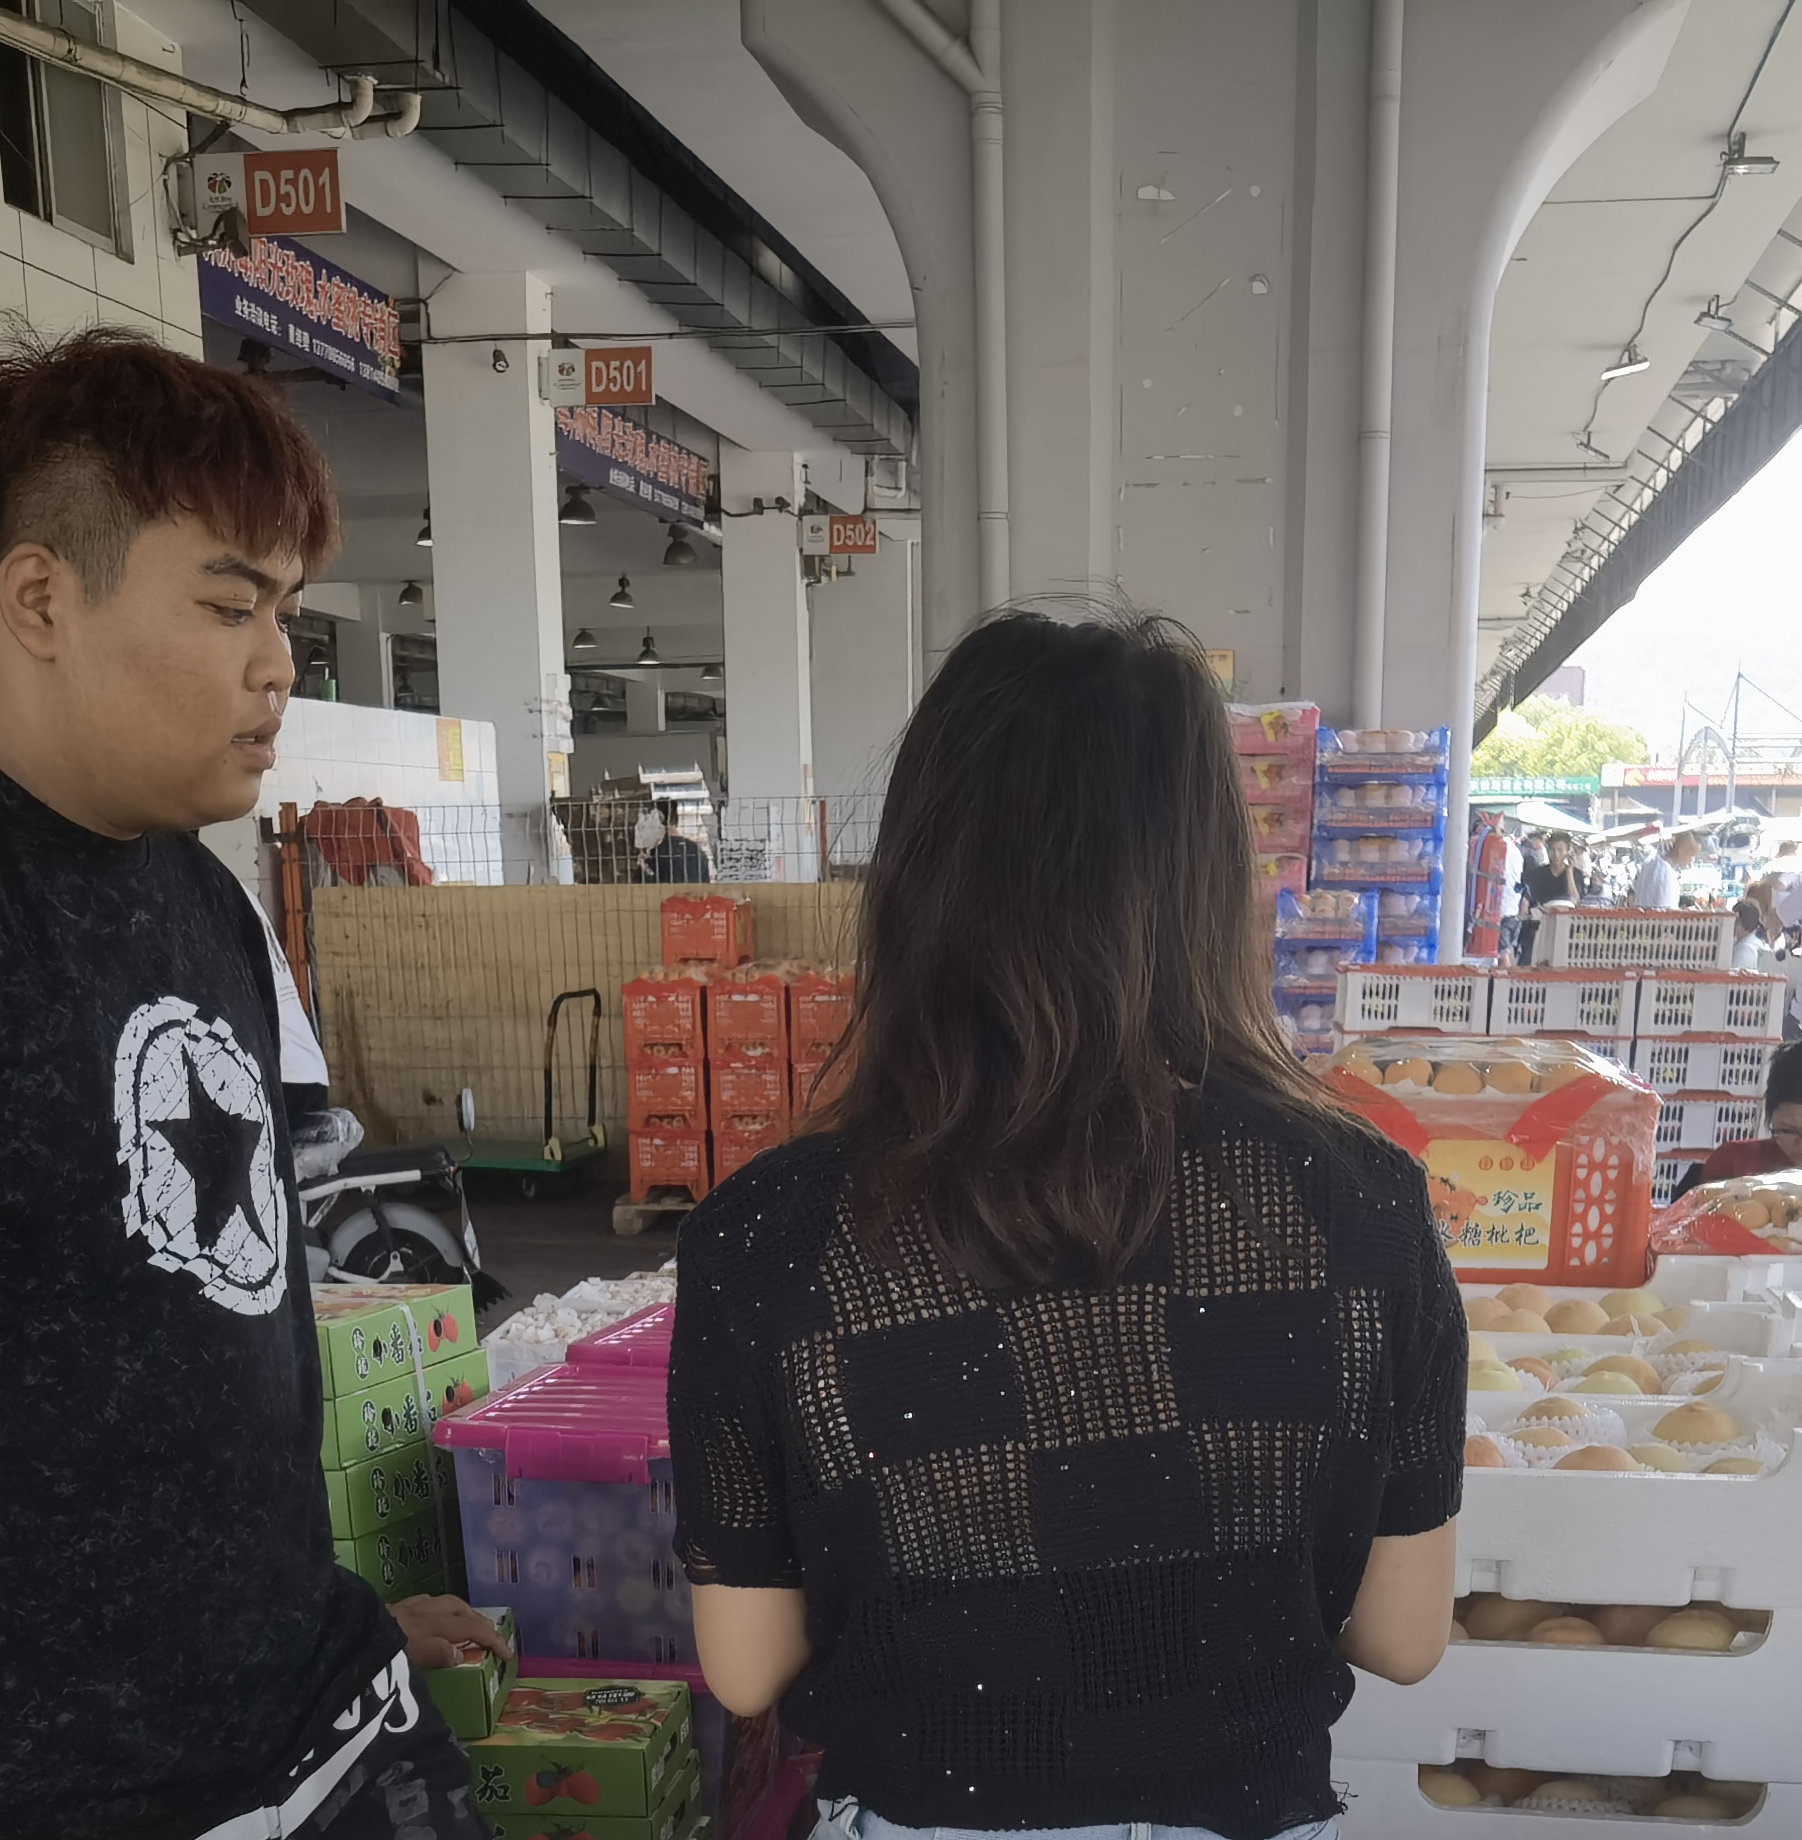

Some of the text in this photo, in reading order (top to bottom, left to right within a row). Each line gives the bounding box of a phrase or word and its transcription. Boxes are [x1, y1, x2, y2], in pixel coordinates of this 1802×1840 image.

[254, 167, 332, 217] D501
[591, 359, 646, 393] D501
[833, 521, 875, 547] D502
[1493, 1190, 1542, 1213] 珍品
[476, 1764, 512, 1803] 茄
